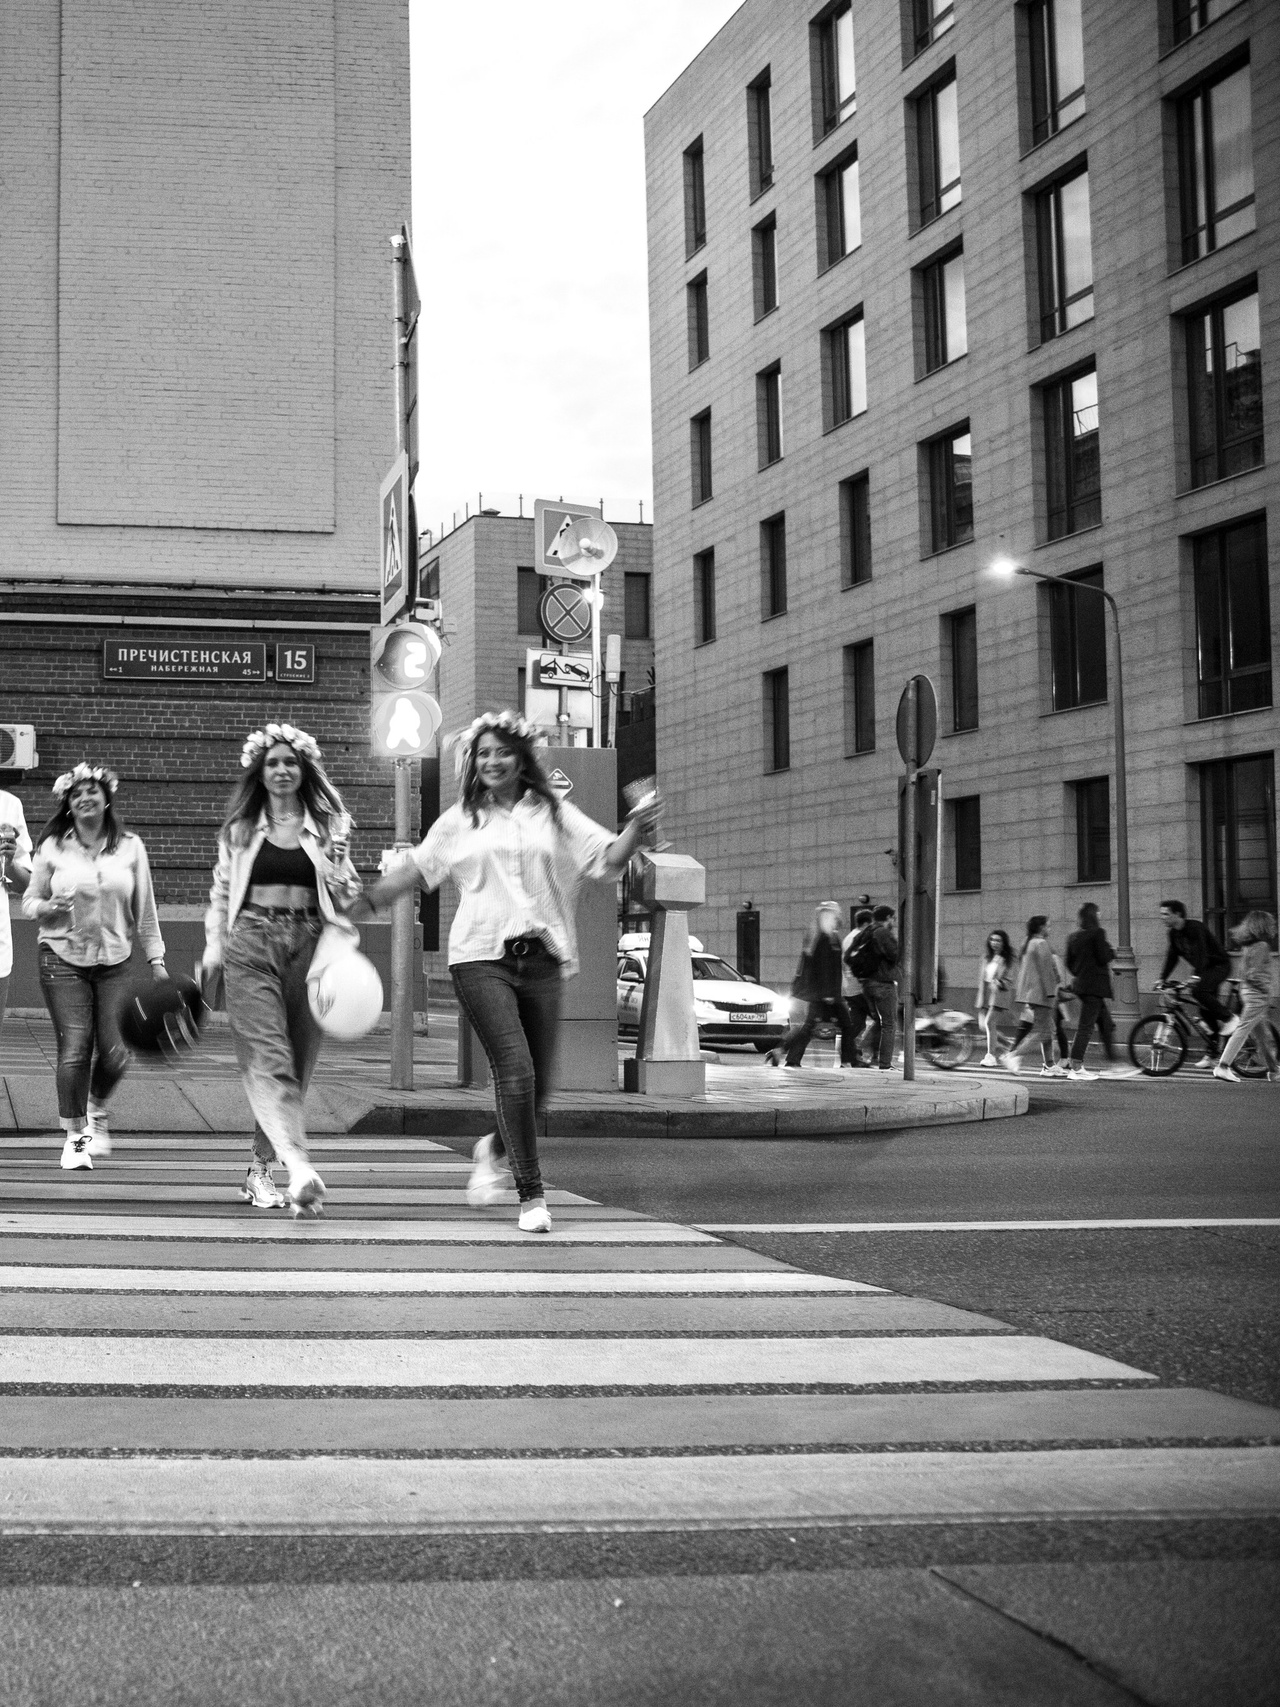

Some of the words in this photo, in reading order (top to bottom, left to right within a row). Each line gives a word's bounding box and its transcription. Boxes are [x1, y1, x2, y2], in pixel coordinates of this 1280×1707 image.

[118, 648, 252, 664] ПРЕЧИСТЕНСКАЯ
[284, 650, 307, 670] 15
[404, 641, 427, 679] 2
[150, 665, 219, 673] НАБЕРЕЖНАЯ
